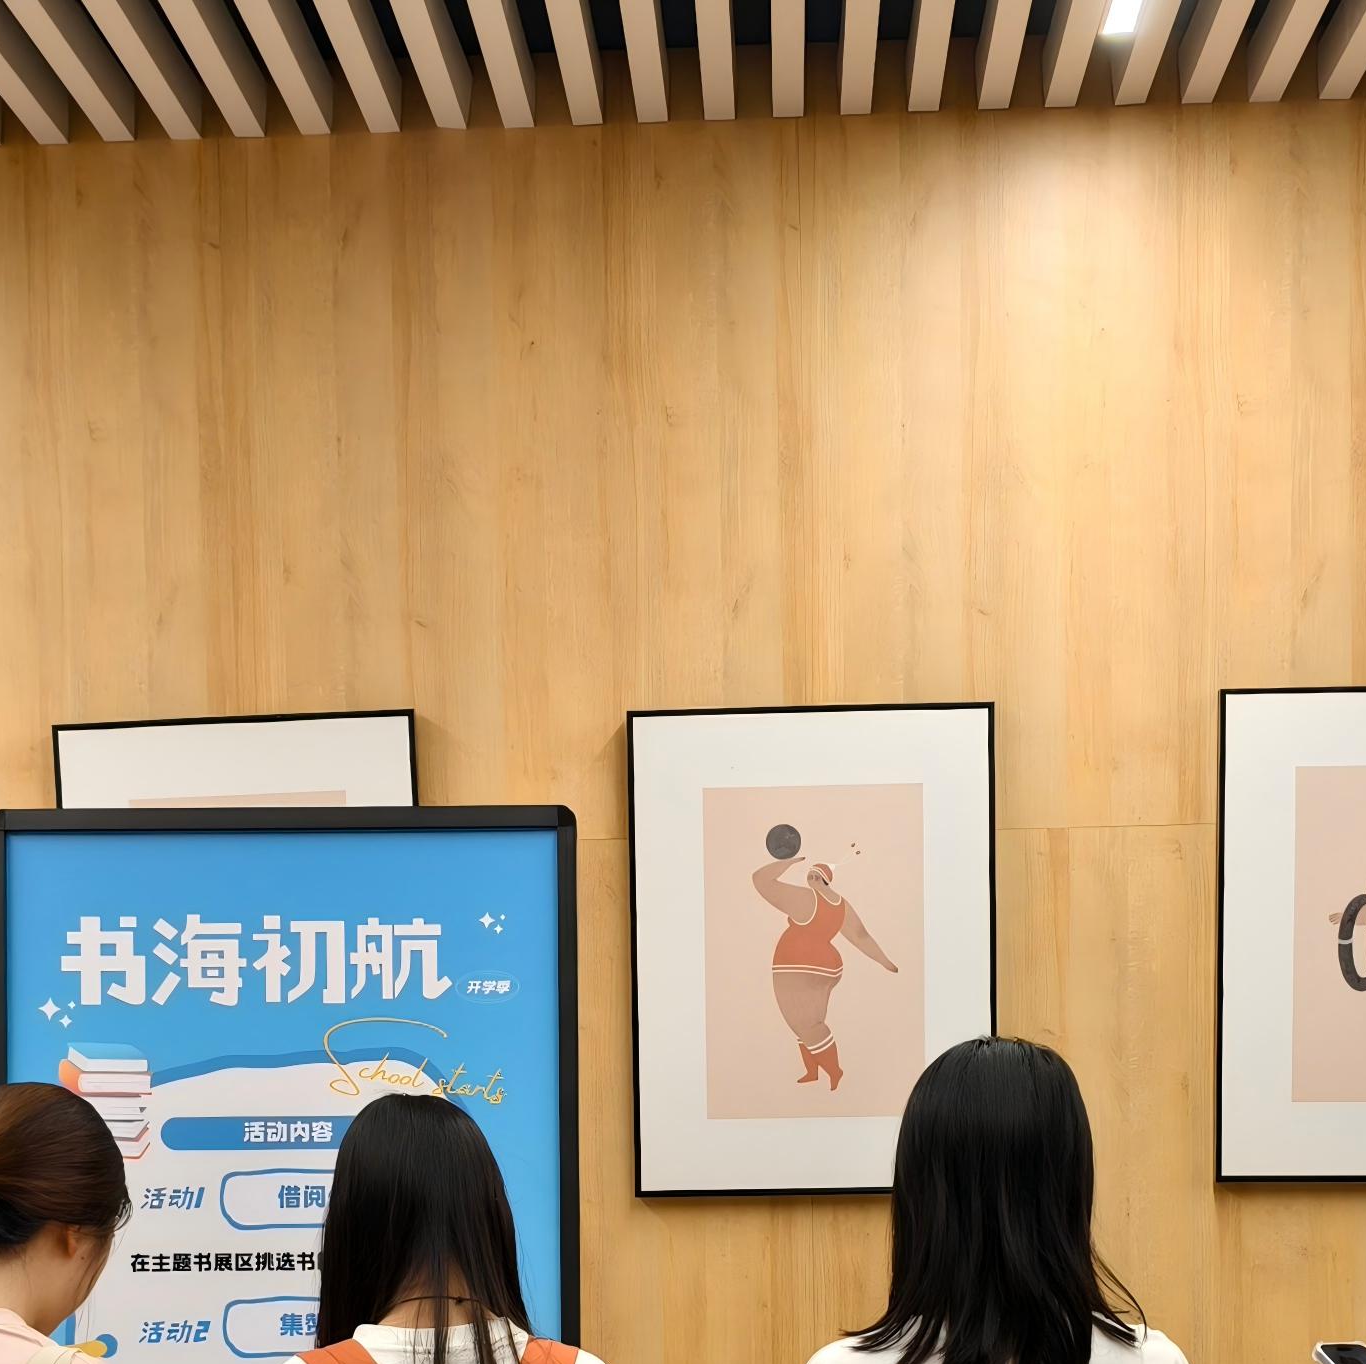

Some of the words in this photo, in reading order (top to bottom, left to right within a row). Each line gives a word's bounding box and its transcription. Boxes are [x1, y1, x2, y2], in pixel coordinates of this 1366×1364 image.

[61, 913, 453, 1007] 书海初航
[323, 1017, 448, 1096] School
[243, 1121, 334, 1143] 活动内容
[140, 1186, 205, 1211] 活动1
[130, 1251, 322, 1273] 在主题书展区挑选书
[139, 1320, 211, 1345] 活动2
